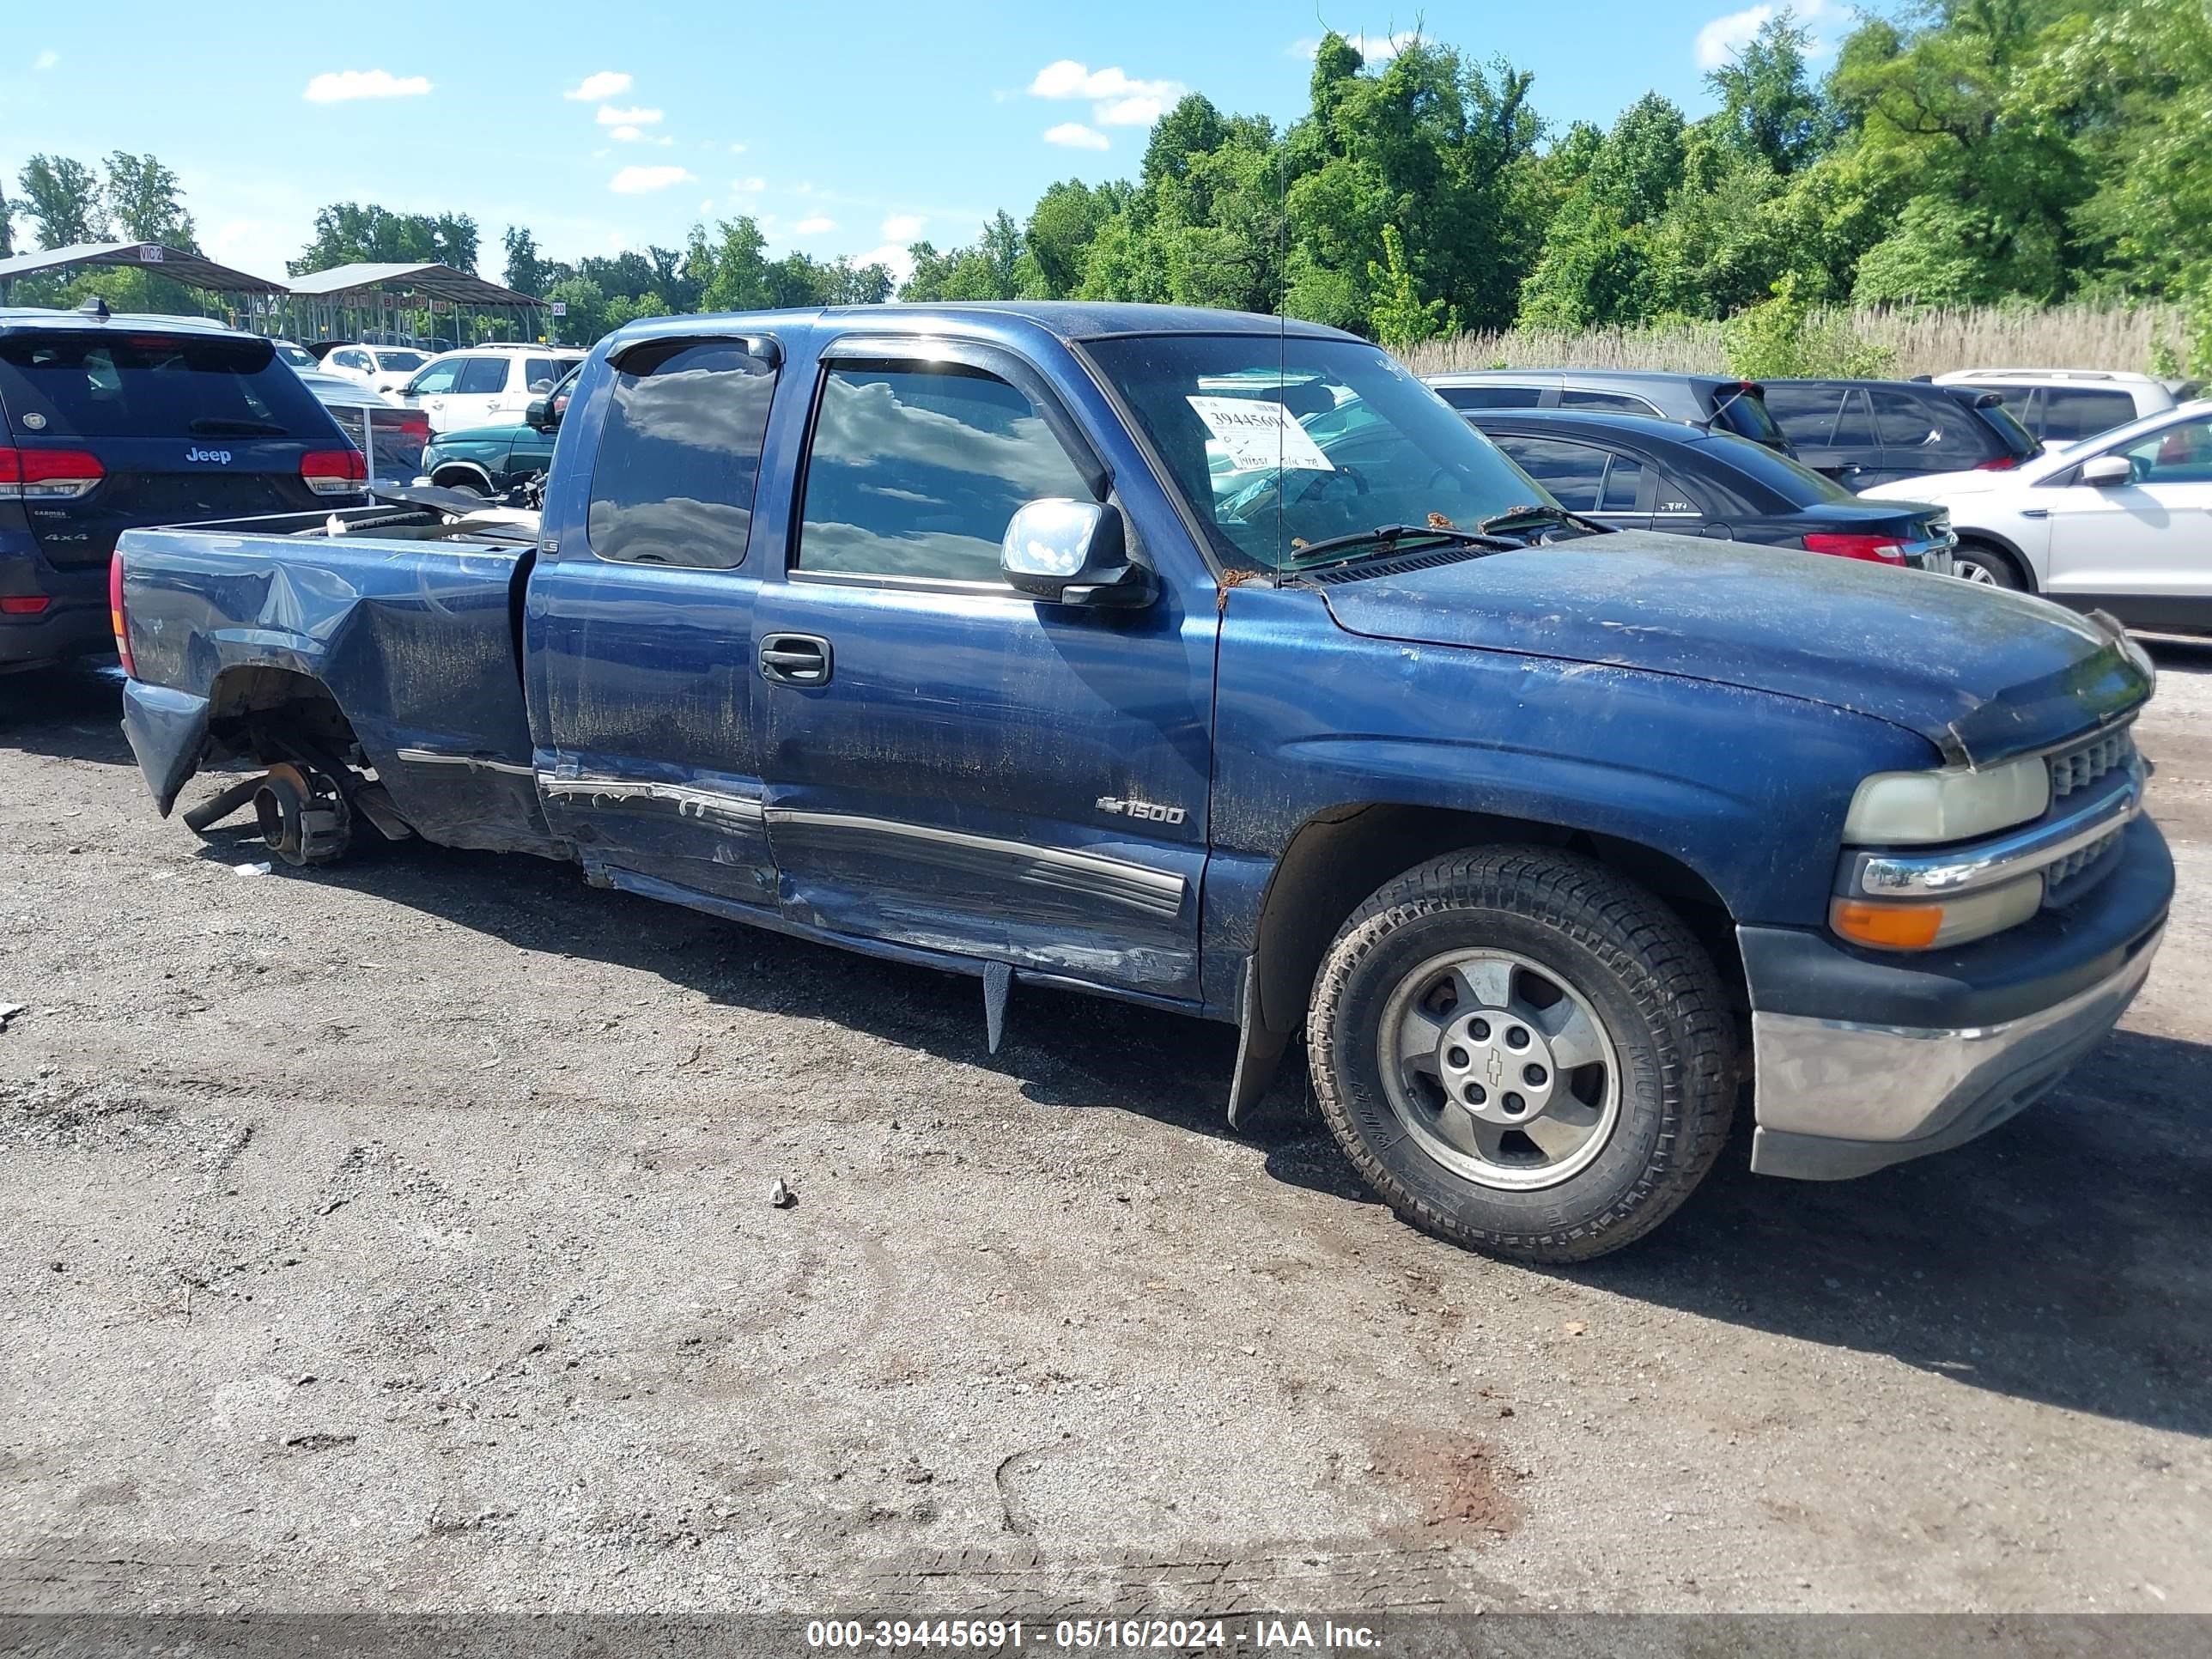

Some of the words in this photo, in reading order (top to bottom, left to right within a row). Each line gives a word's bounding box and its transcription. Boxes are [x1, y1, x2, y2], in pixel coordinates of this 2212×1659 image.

[140, 246, 155, 260] VIC
[157, 247, 162, 260] 2
[384, 298, 392, 307] B
[416, 295, 427, 305] 20
[435, 302, 446, 312] 10
[554, 304, 565, 314] 20
[1209, 411, 1291, 430] 39445691
[185, 447, 232, 465] Jeep
[44, 532, 89, 542] 4x4
[542, 541, 558, 552] LS
[1127, 800, 1186, 825] 1500
